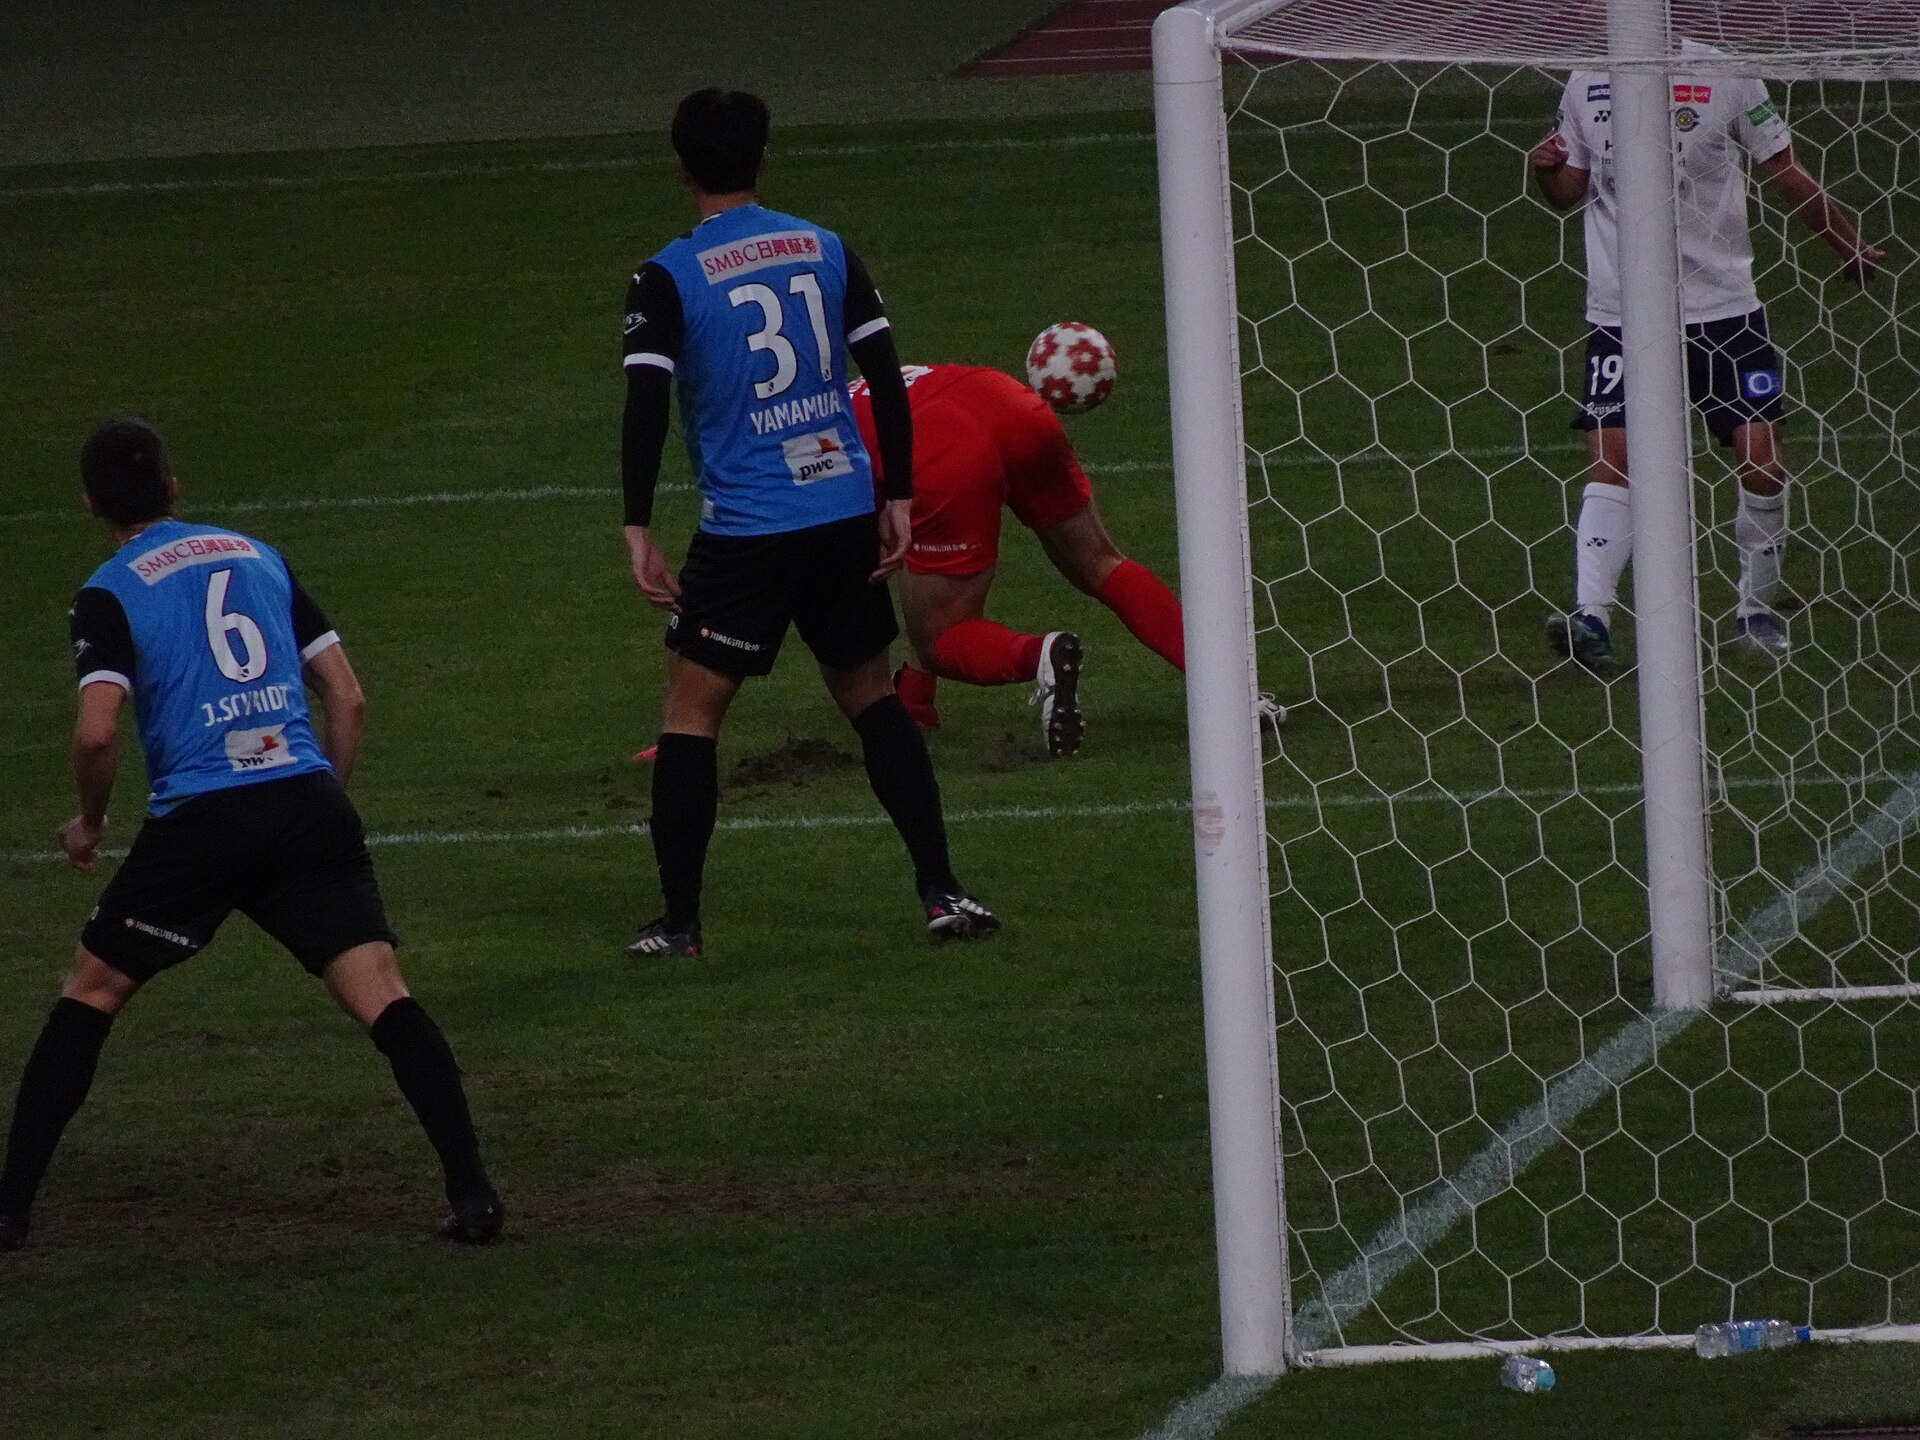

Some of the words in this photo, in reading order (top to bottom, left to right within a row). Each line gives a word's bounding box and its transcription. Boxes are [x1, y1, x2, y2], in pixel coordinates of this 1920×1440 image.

[728, 273, 832, 400] 31
[1590, 354, 1623, 396] 19
[800, 459, 834, 481] pwc
[205, 569, 267, 683] 6
